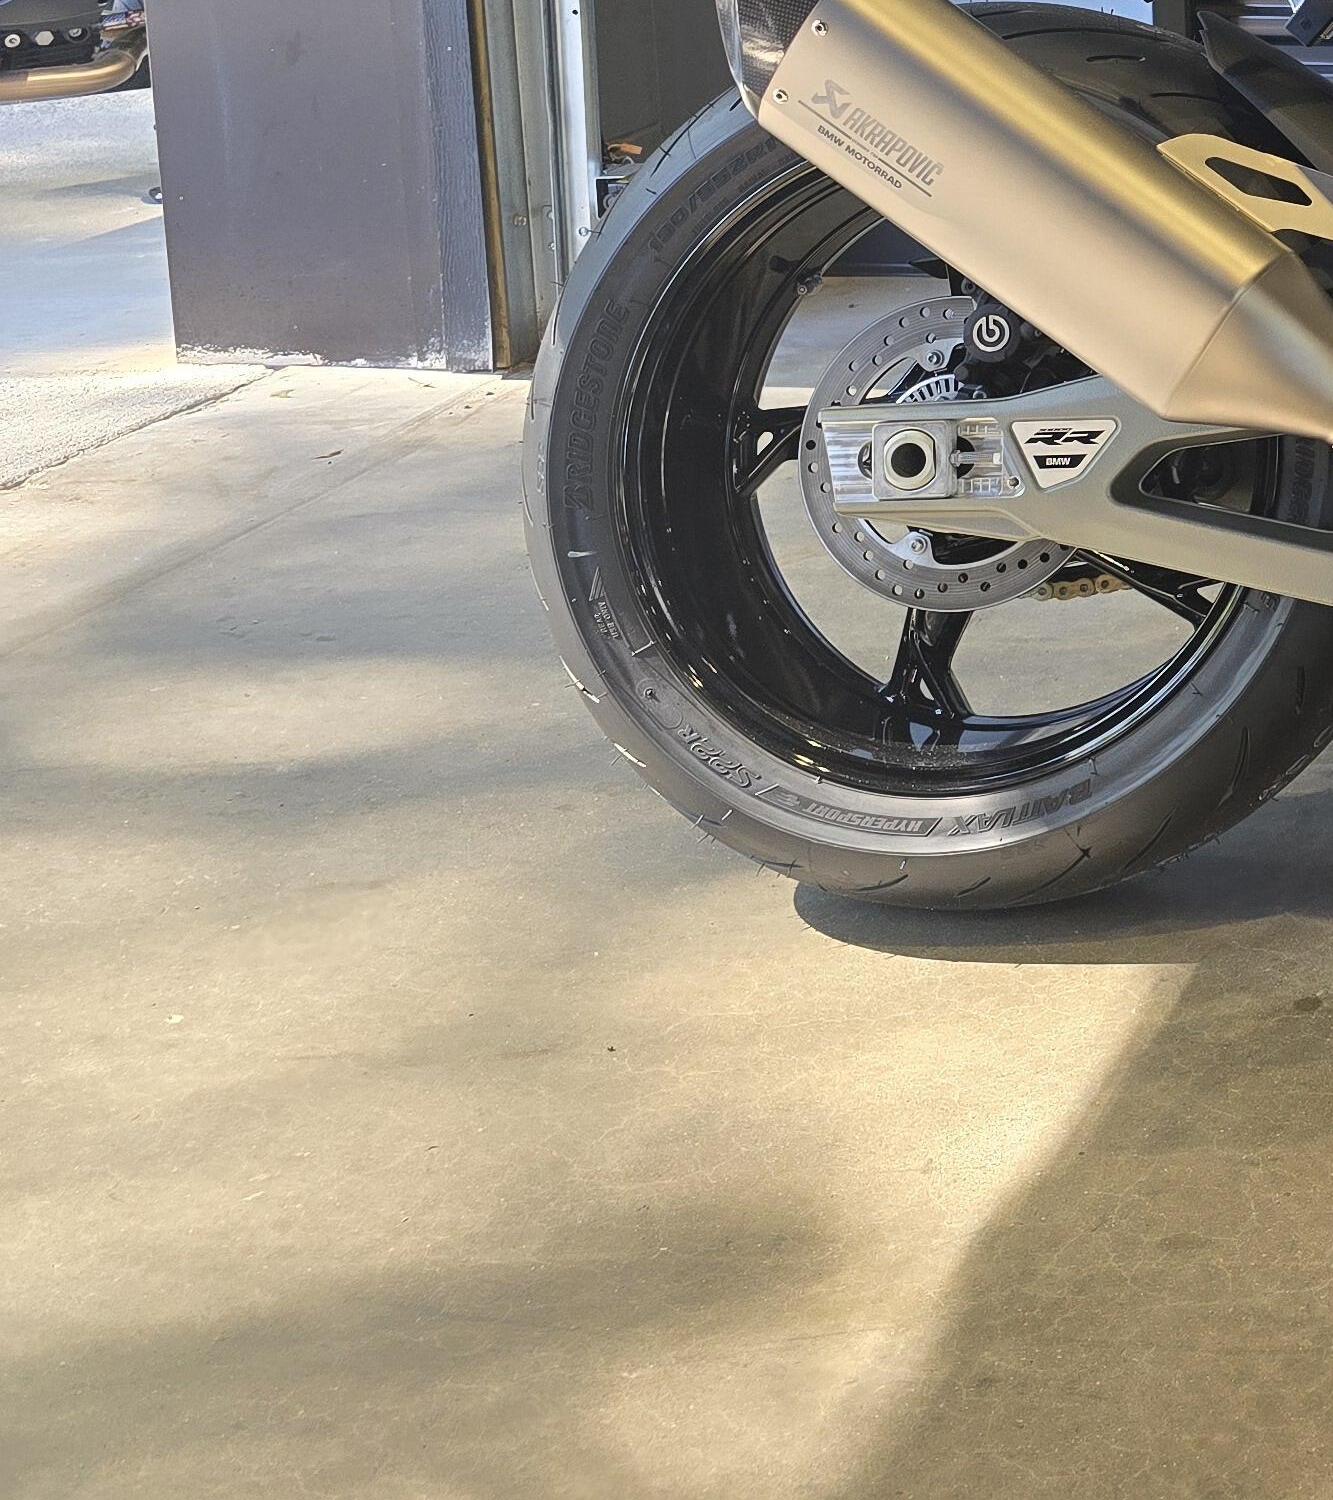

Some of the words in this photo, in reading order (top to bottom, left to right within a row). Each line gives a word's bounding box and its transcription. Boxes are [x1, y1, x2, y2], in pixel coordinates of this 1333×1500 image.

[817, 124, 845, 147] BMW
[845, 144, 902, 189] MOTORRAD
[563, 299, 630, 510] BRIDGESTONE
[1024, 430, 1106, 446] RR
[1045, 457, 1071, 466] BMW
[677, 723, 761, 788] S22R
[802, 802, 923, 833] HYPERSPORT
[948, 778, 1093, 836] BATTLAX
